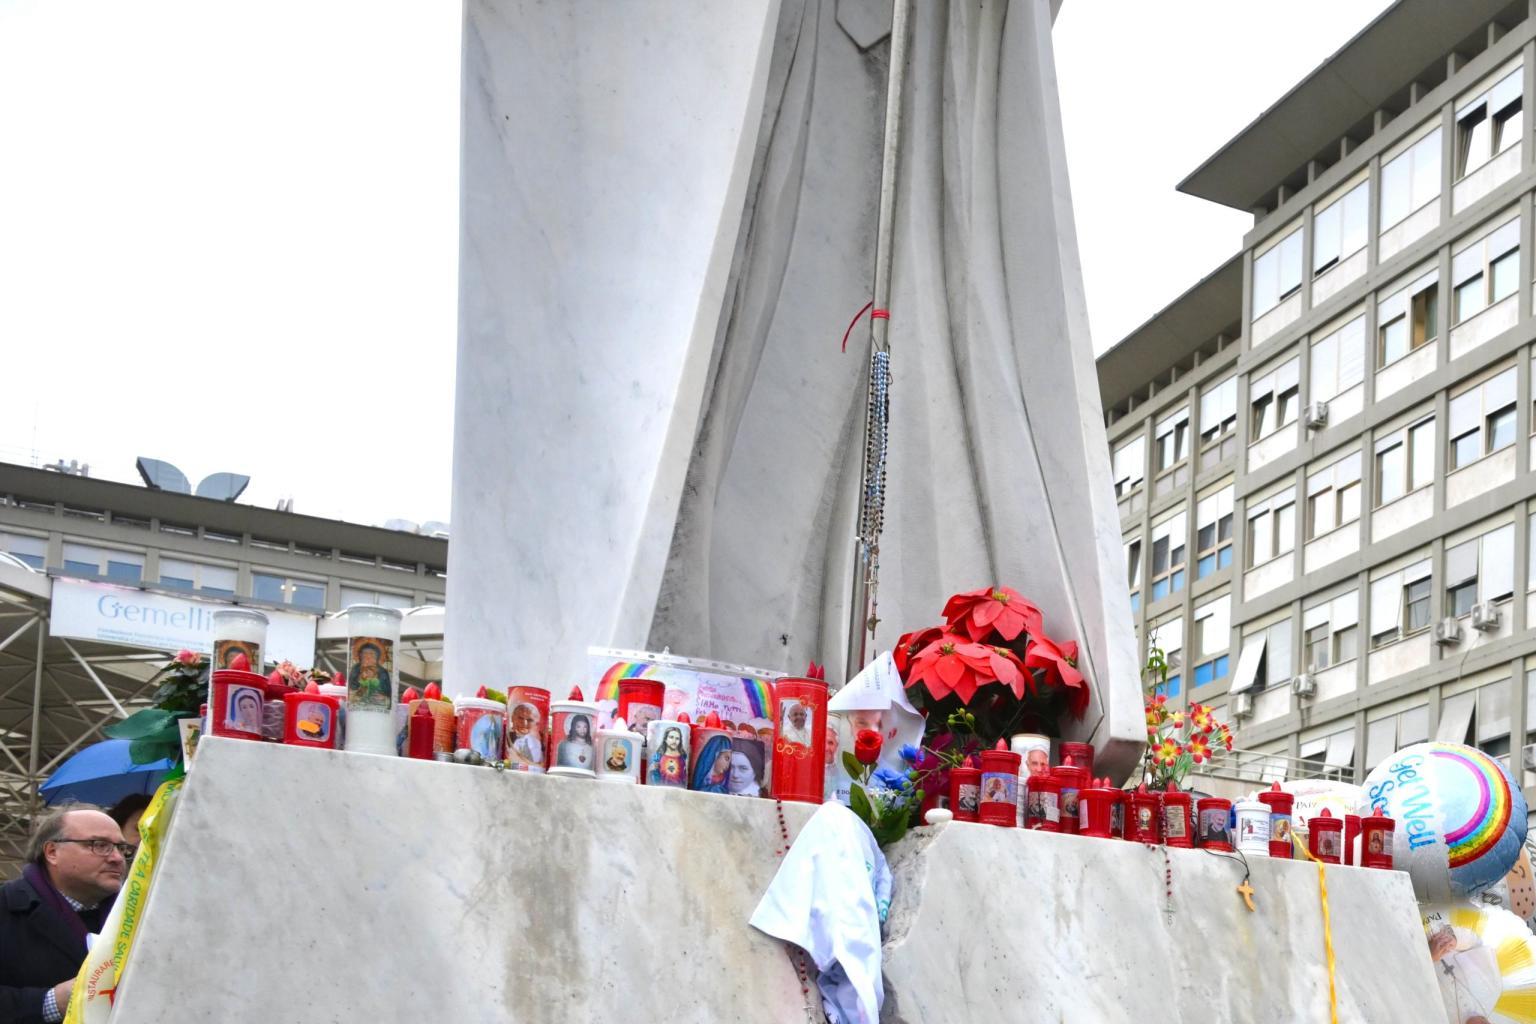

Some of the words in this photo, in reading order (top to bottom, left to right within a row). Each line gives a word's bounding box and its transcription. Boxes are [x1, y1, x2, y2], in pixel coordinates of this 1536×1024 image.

[97, 594, 211, 632] Gemelli
[1389, 754, 1425, 787] Get
[1402, 782, 1437, 852] Well
[119, 881, 142, 939] CARIDADE
